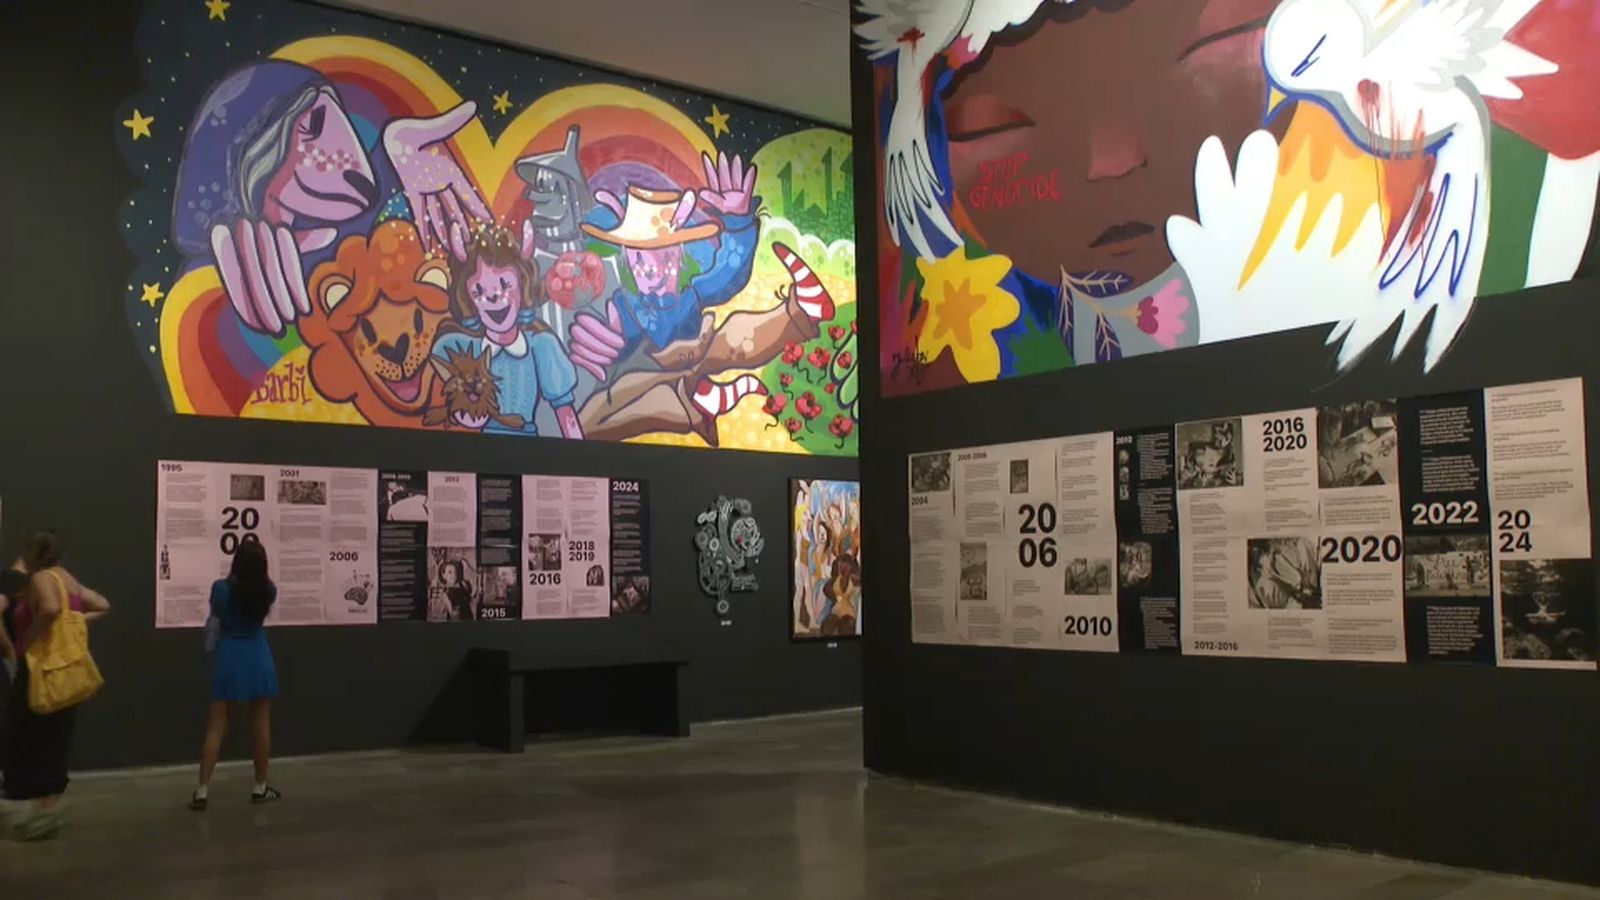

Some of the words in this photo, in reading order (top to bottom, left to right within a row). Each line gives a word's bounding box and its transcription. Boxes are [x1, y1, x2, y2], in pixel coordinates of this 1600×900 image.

[968, 169, 1063, 211] GENOCIDE
[1262, 416, 1304, 436] 2016
[1263, 433, 1307, 452] 2020
[279, 468, 300, 478] 2001
[612, 480, 639, 492] 2024
[222, 507, 259, 530] 20
[1018, 503, 1057, 534] 20
[1411, 501, 1479, 525] 2022
[1498, 510, 1531, 530] 20
[569, 541, 595, 551] 2018
[1321, 535, 1402, 563] 2020
[1499, 531, 1533, 552] 24
[329, 551, 359, 562] 2006
[569, 551, 595, 562] 2019
[1018, 537, 1057, 568] 06
[529, 573, 562, 586] 2016
[481, 608, 506, 618] 2015
[1064, 616, 1112, 636] 2010
